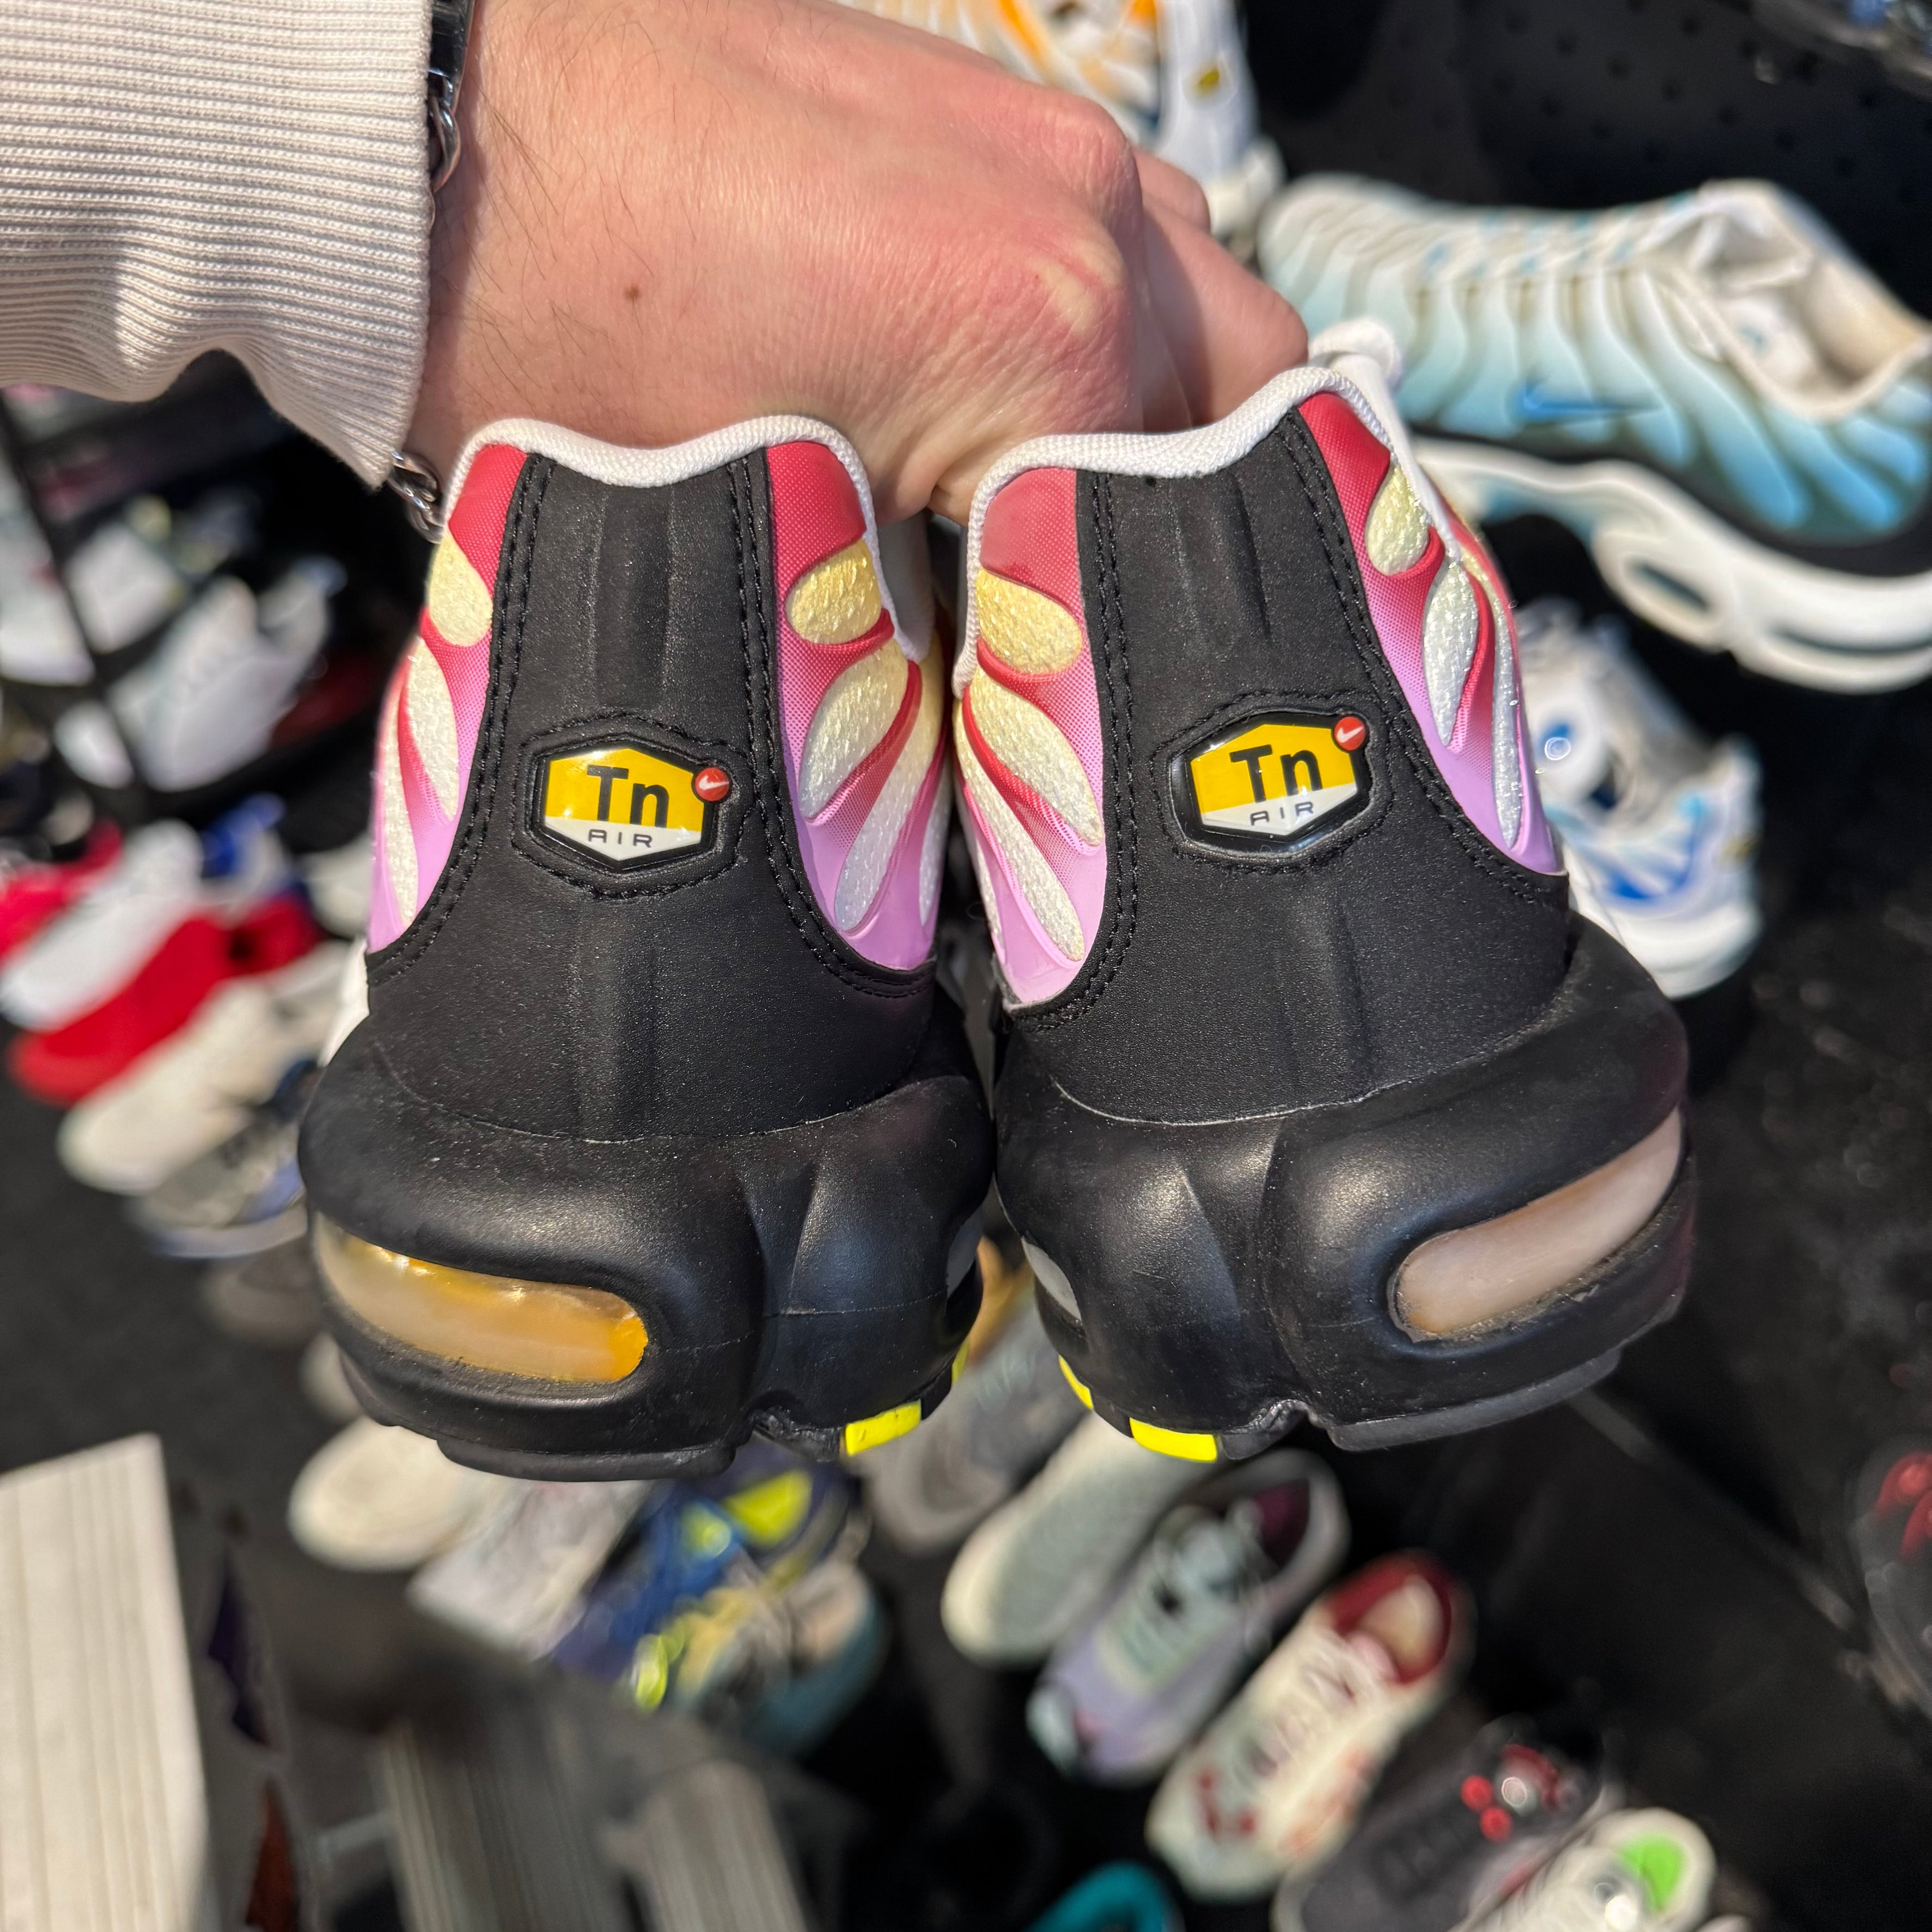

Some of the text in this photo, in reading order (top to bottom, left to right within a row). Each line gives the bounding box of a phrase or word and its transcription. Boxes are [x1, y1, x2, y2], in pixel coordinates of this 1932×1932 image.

[1230, 745, 1323, 803] Tn
[587, 765, 669, 828] Tn
[1250, 801, 1314, 825] AIR
[589, 829, 653, 848] AIR
